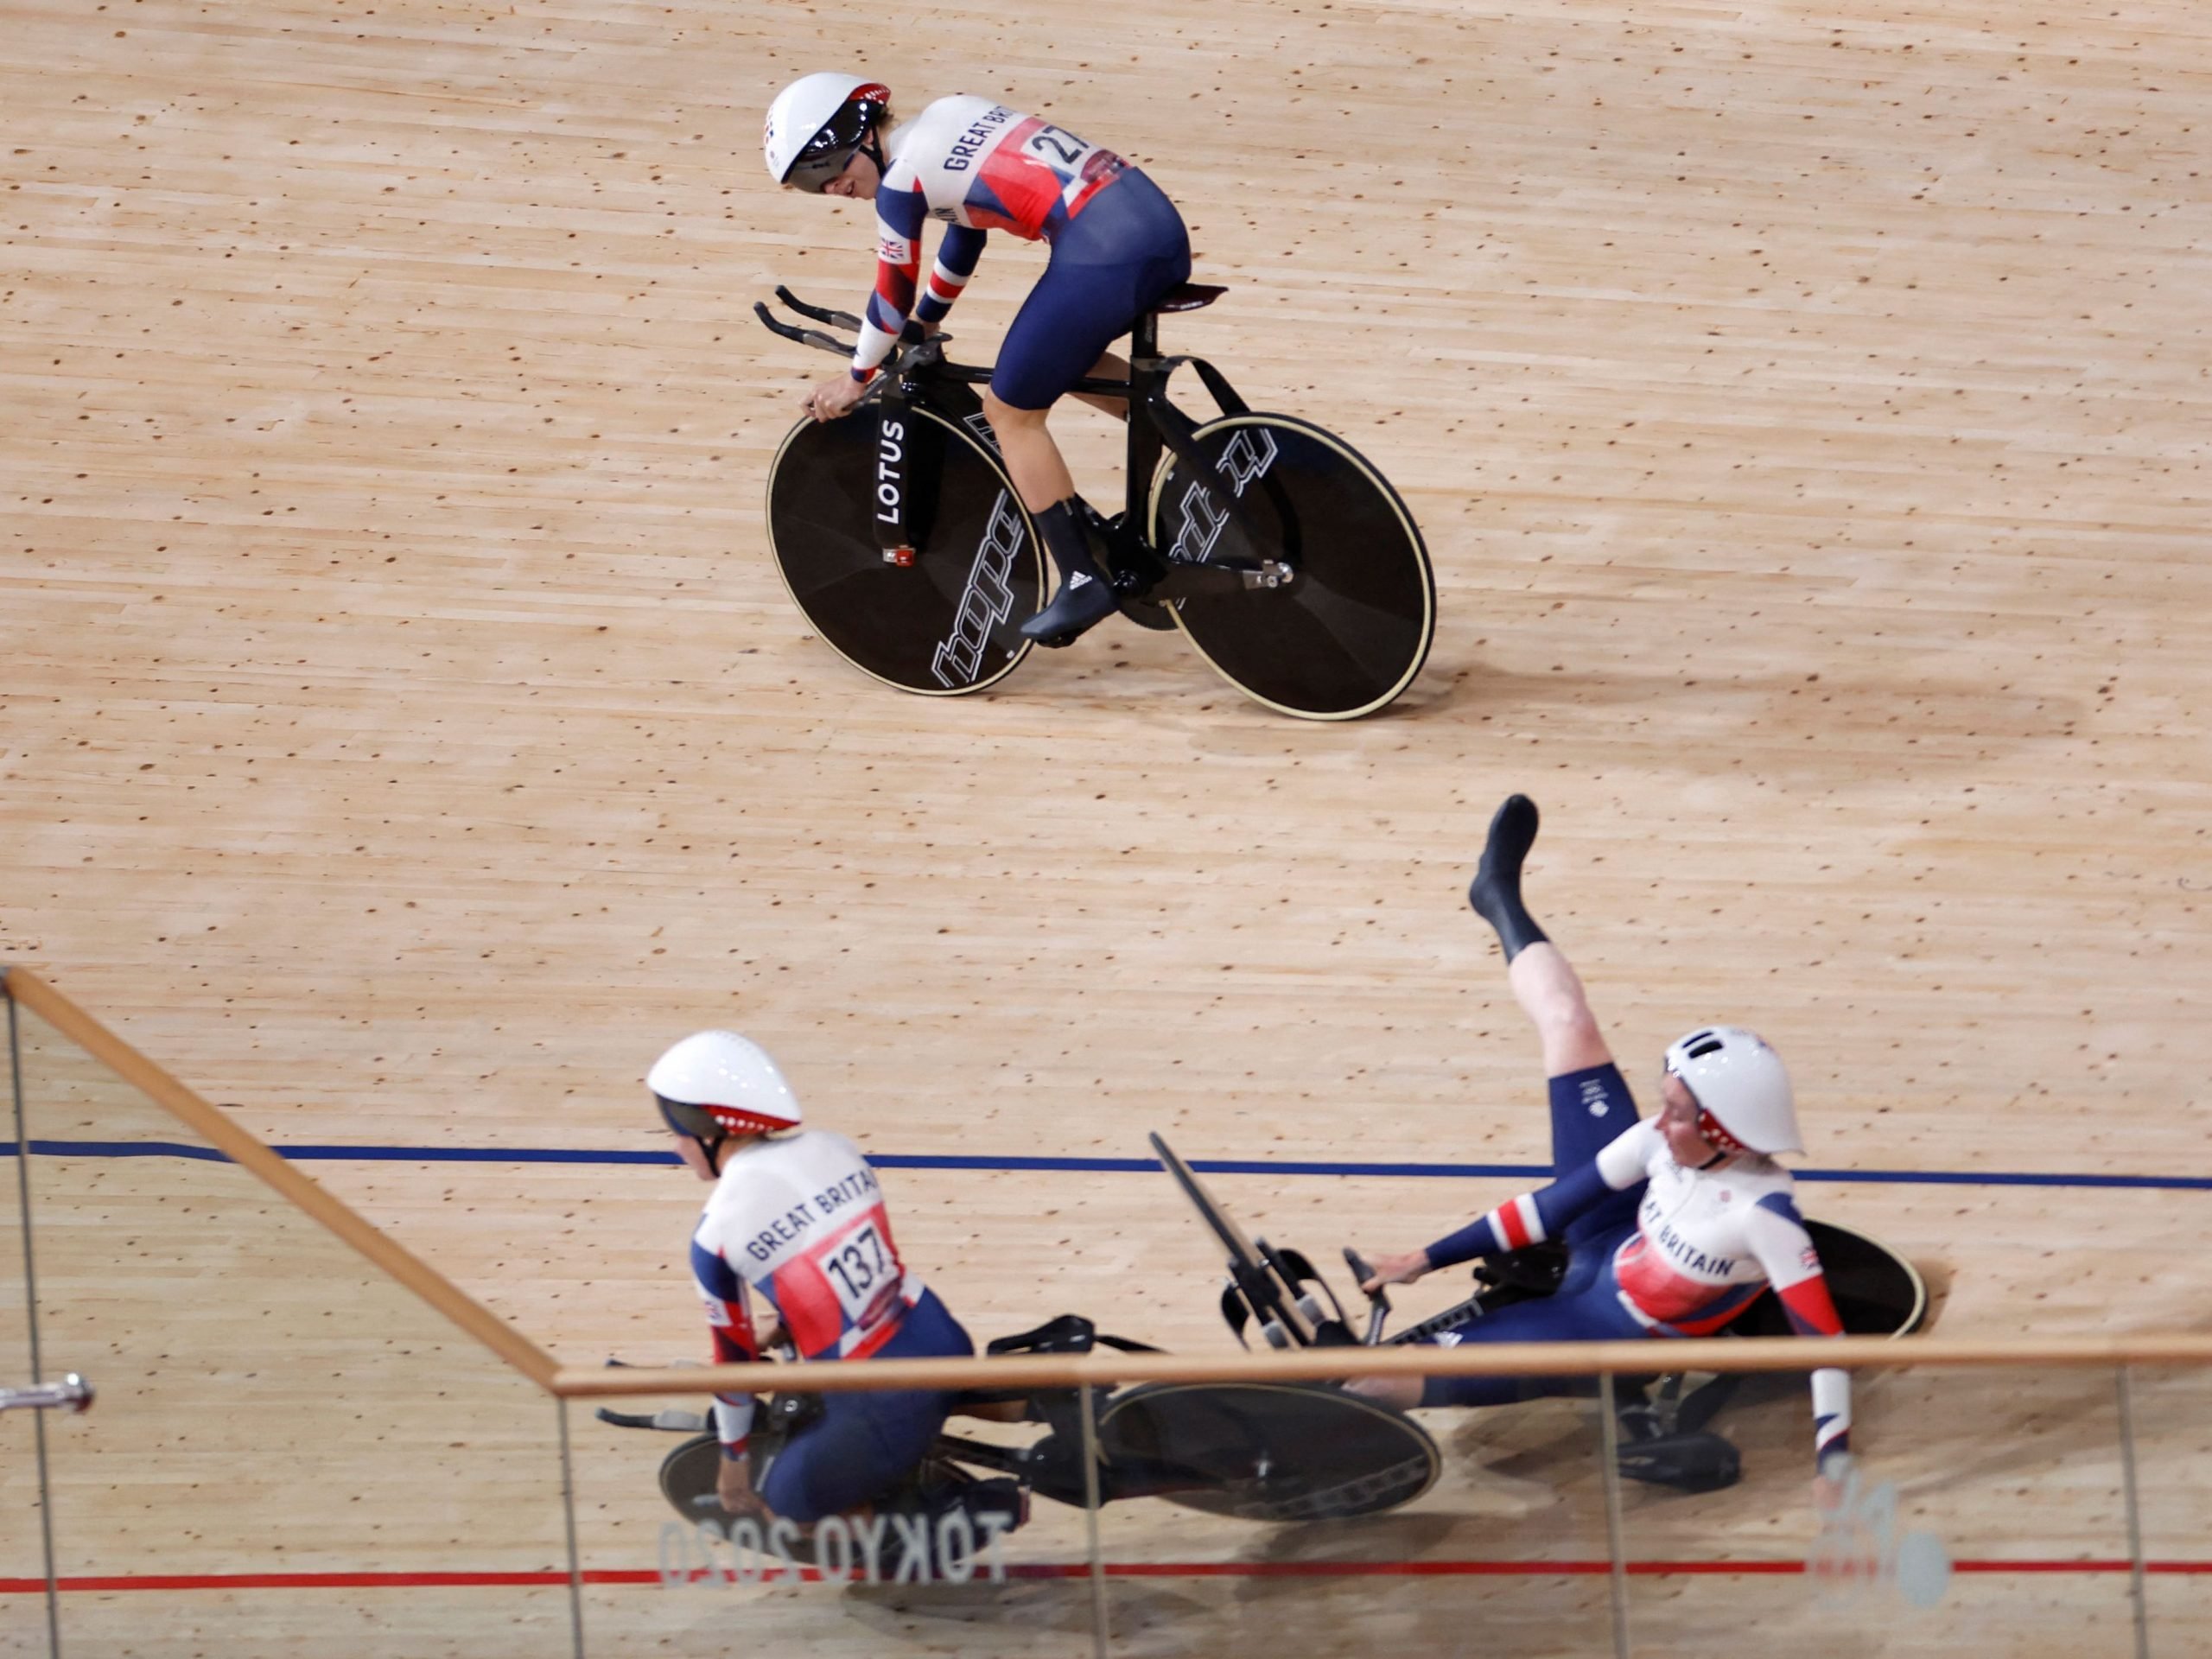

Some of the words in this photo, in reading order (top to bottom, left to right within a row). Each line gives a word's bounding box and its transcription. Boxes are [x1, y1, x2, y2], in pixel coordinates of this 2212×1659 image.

[944, 122, 996, 171] GREAT
[1032, 125, 1090, 164] 27
[876, 419, 904, 524] LOTUS
[931, 488, 1025, 688] hope
[746, 1204, 816, 1261] GREAT
[1659, 1225, 1735, 1275] BRITAIN
[829, 1227, 883, 1298] 137
